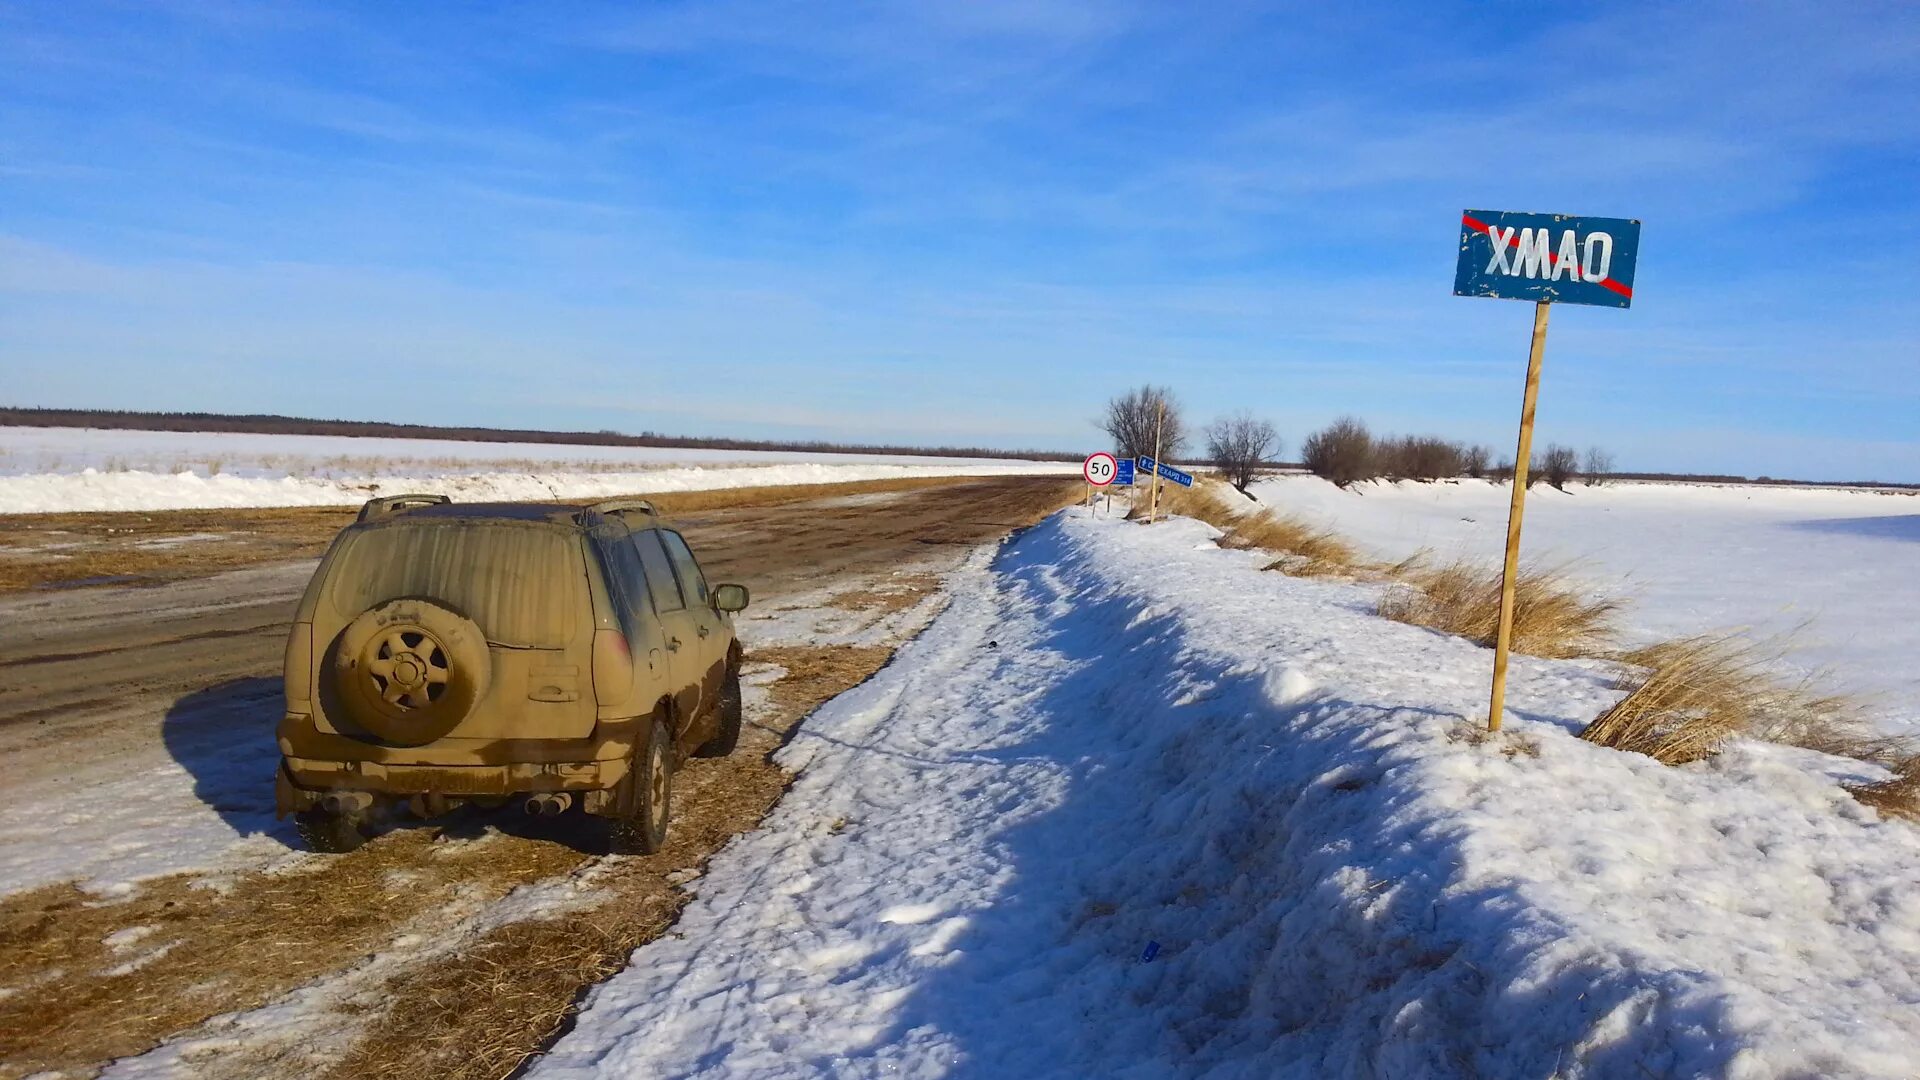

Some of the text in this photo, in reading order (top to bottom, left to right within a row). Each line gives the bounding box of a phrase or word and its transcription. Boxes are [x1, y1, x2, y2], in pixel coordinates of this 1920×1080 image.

[1484, 225, 1613, 283] ХМАО
[1090, 462, 1110, 476] 50
[1147, 462, 1180, 481] СЕХАРД
